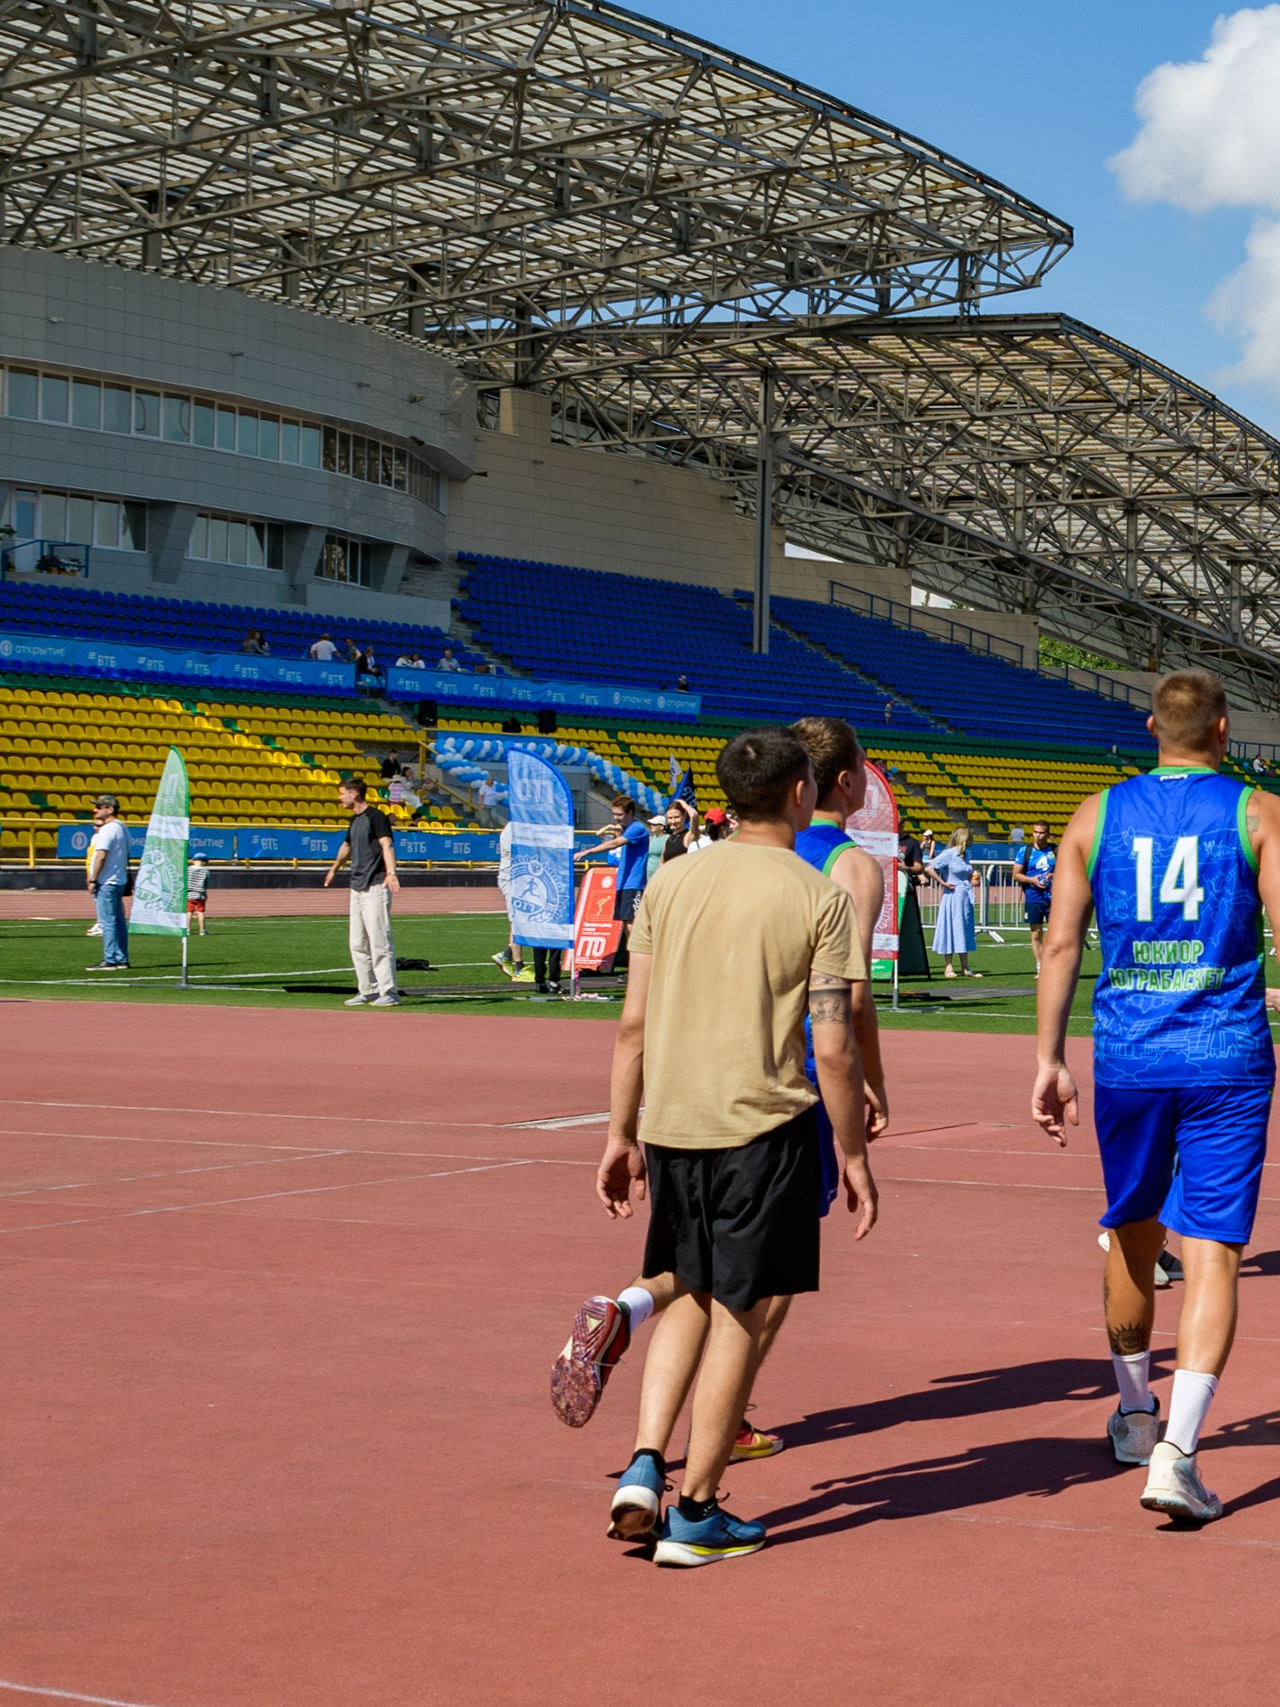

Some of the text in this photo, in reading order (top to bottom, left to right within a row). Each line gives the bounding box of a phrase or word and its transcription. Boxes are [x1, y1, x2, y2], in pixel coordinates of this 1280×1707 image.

[97, 655, 116, 667] ВТБ
[242, 667, 258, 678] ВТБ
[286, 671, 302, 682] ВТБ
[328, 674, 344, 684] ВТБ
[443, 683, 458, 694] ВТБ
[261, 838, 278, 850] ВТБ
[310, 839, 328, 852] ВТБ
[406, 841, 426, 853] ВТБ
[452, 842, 471, 854] ВТБ
[1036, 855, 1050, 871] 4
[1132, 835, 1204, 922] 14
[576, 936, 607, 958] ГТО
[1133, 940, 1204, 964] ЮКИОР
[1109, 966, 1226, 992] ЮГРАБАСКЕТ
